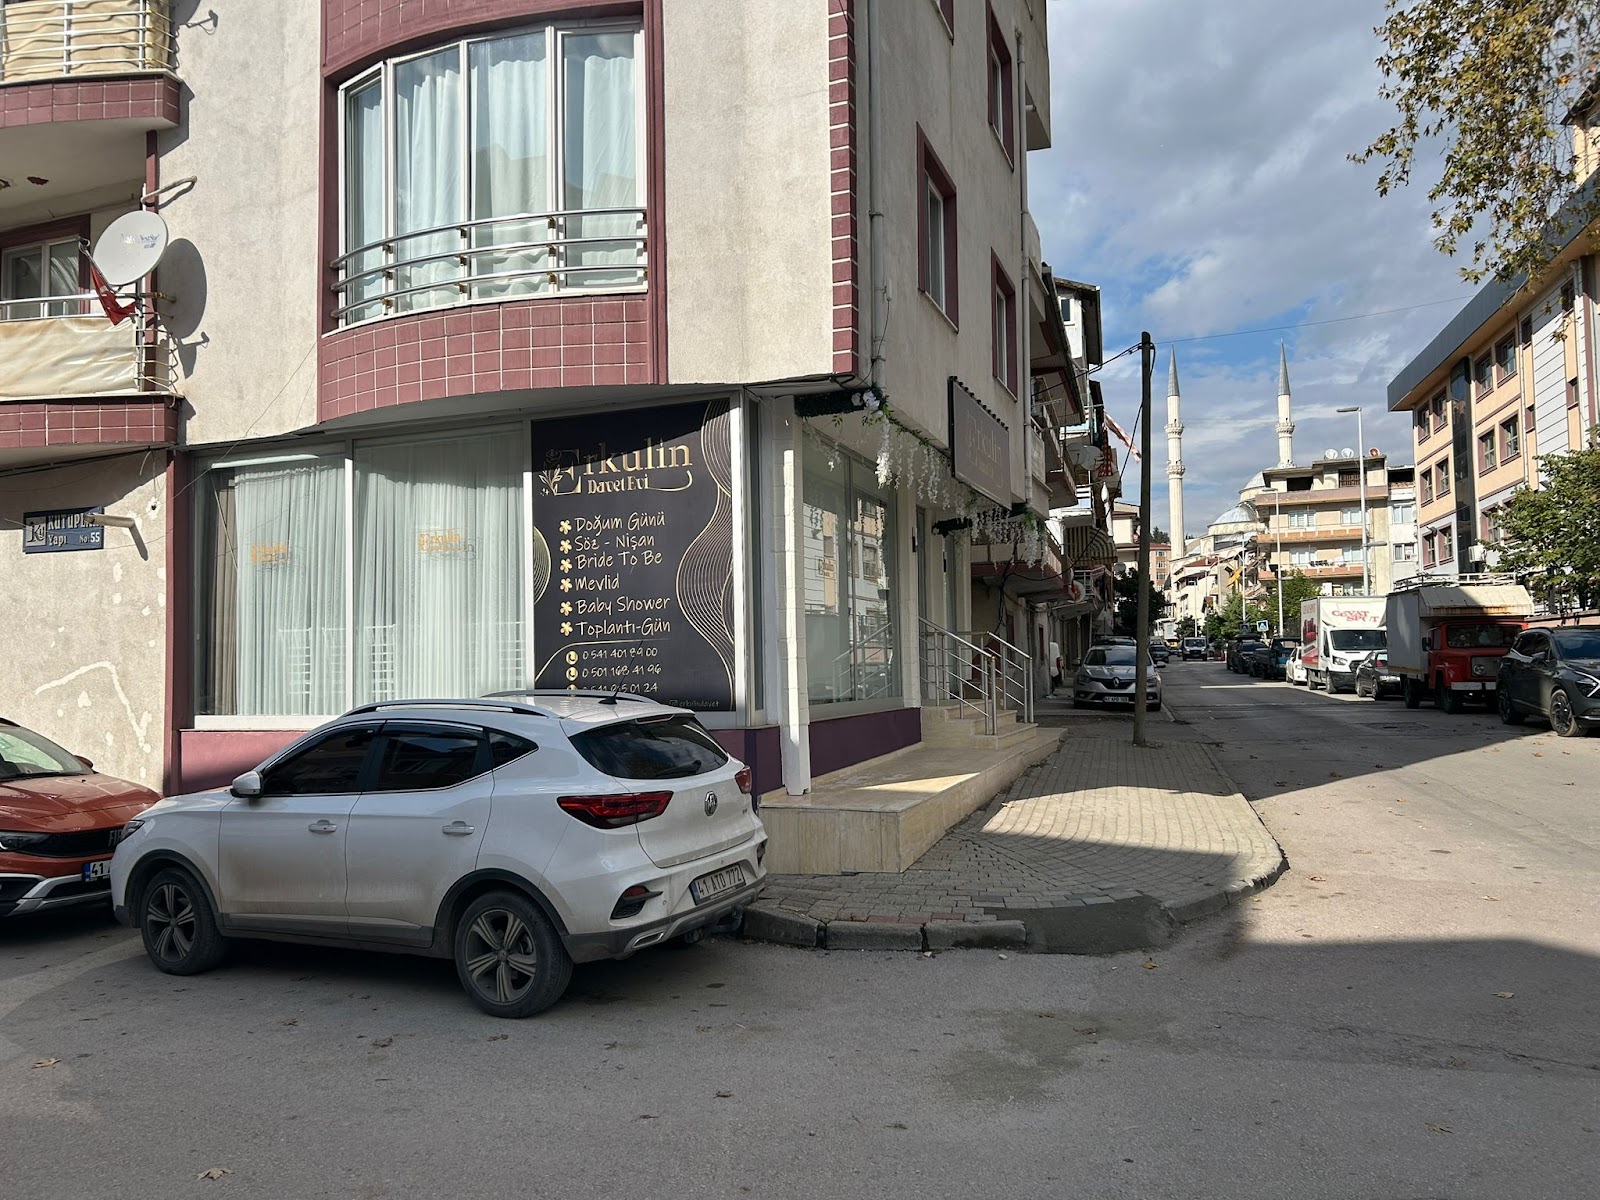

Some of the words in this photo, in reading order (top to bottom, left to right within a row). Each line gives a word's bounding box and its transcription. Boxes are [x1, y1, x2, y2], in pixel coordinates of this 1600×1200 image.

[548, 437, 693, 495] Erkulin
[588, 477, 625, 494] Davet
[627, 474, 649, 490] Evi
[48, 513, 100, 530] KUTUPL
[574, 514, 623, 536] Doğum
[627, 511, 666, 531] Günü
[574, 535, 600, 552] Söz
[616, 532, 655, 551] Nişan
[575, 551, 614, 570] Bride
[617, 550, 638, 566] To
[641, 549, 663, 566] Be
[575, 572, 620, 591] Mevlid
[575, 597, 612, 616] Baby
[616, 596, 671, 612] Shower
[575, 617, 671, 639] Toplantı-Gün
[591, 649, 608, 660] 541
[610, 648, 627, 658] 401
[645, 647, 658, 657] 00
[591, 667, 608, 677] 501
[632, 664, 645, 675] 41
[92, 862, 104, 875] 41
